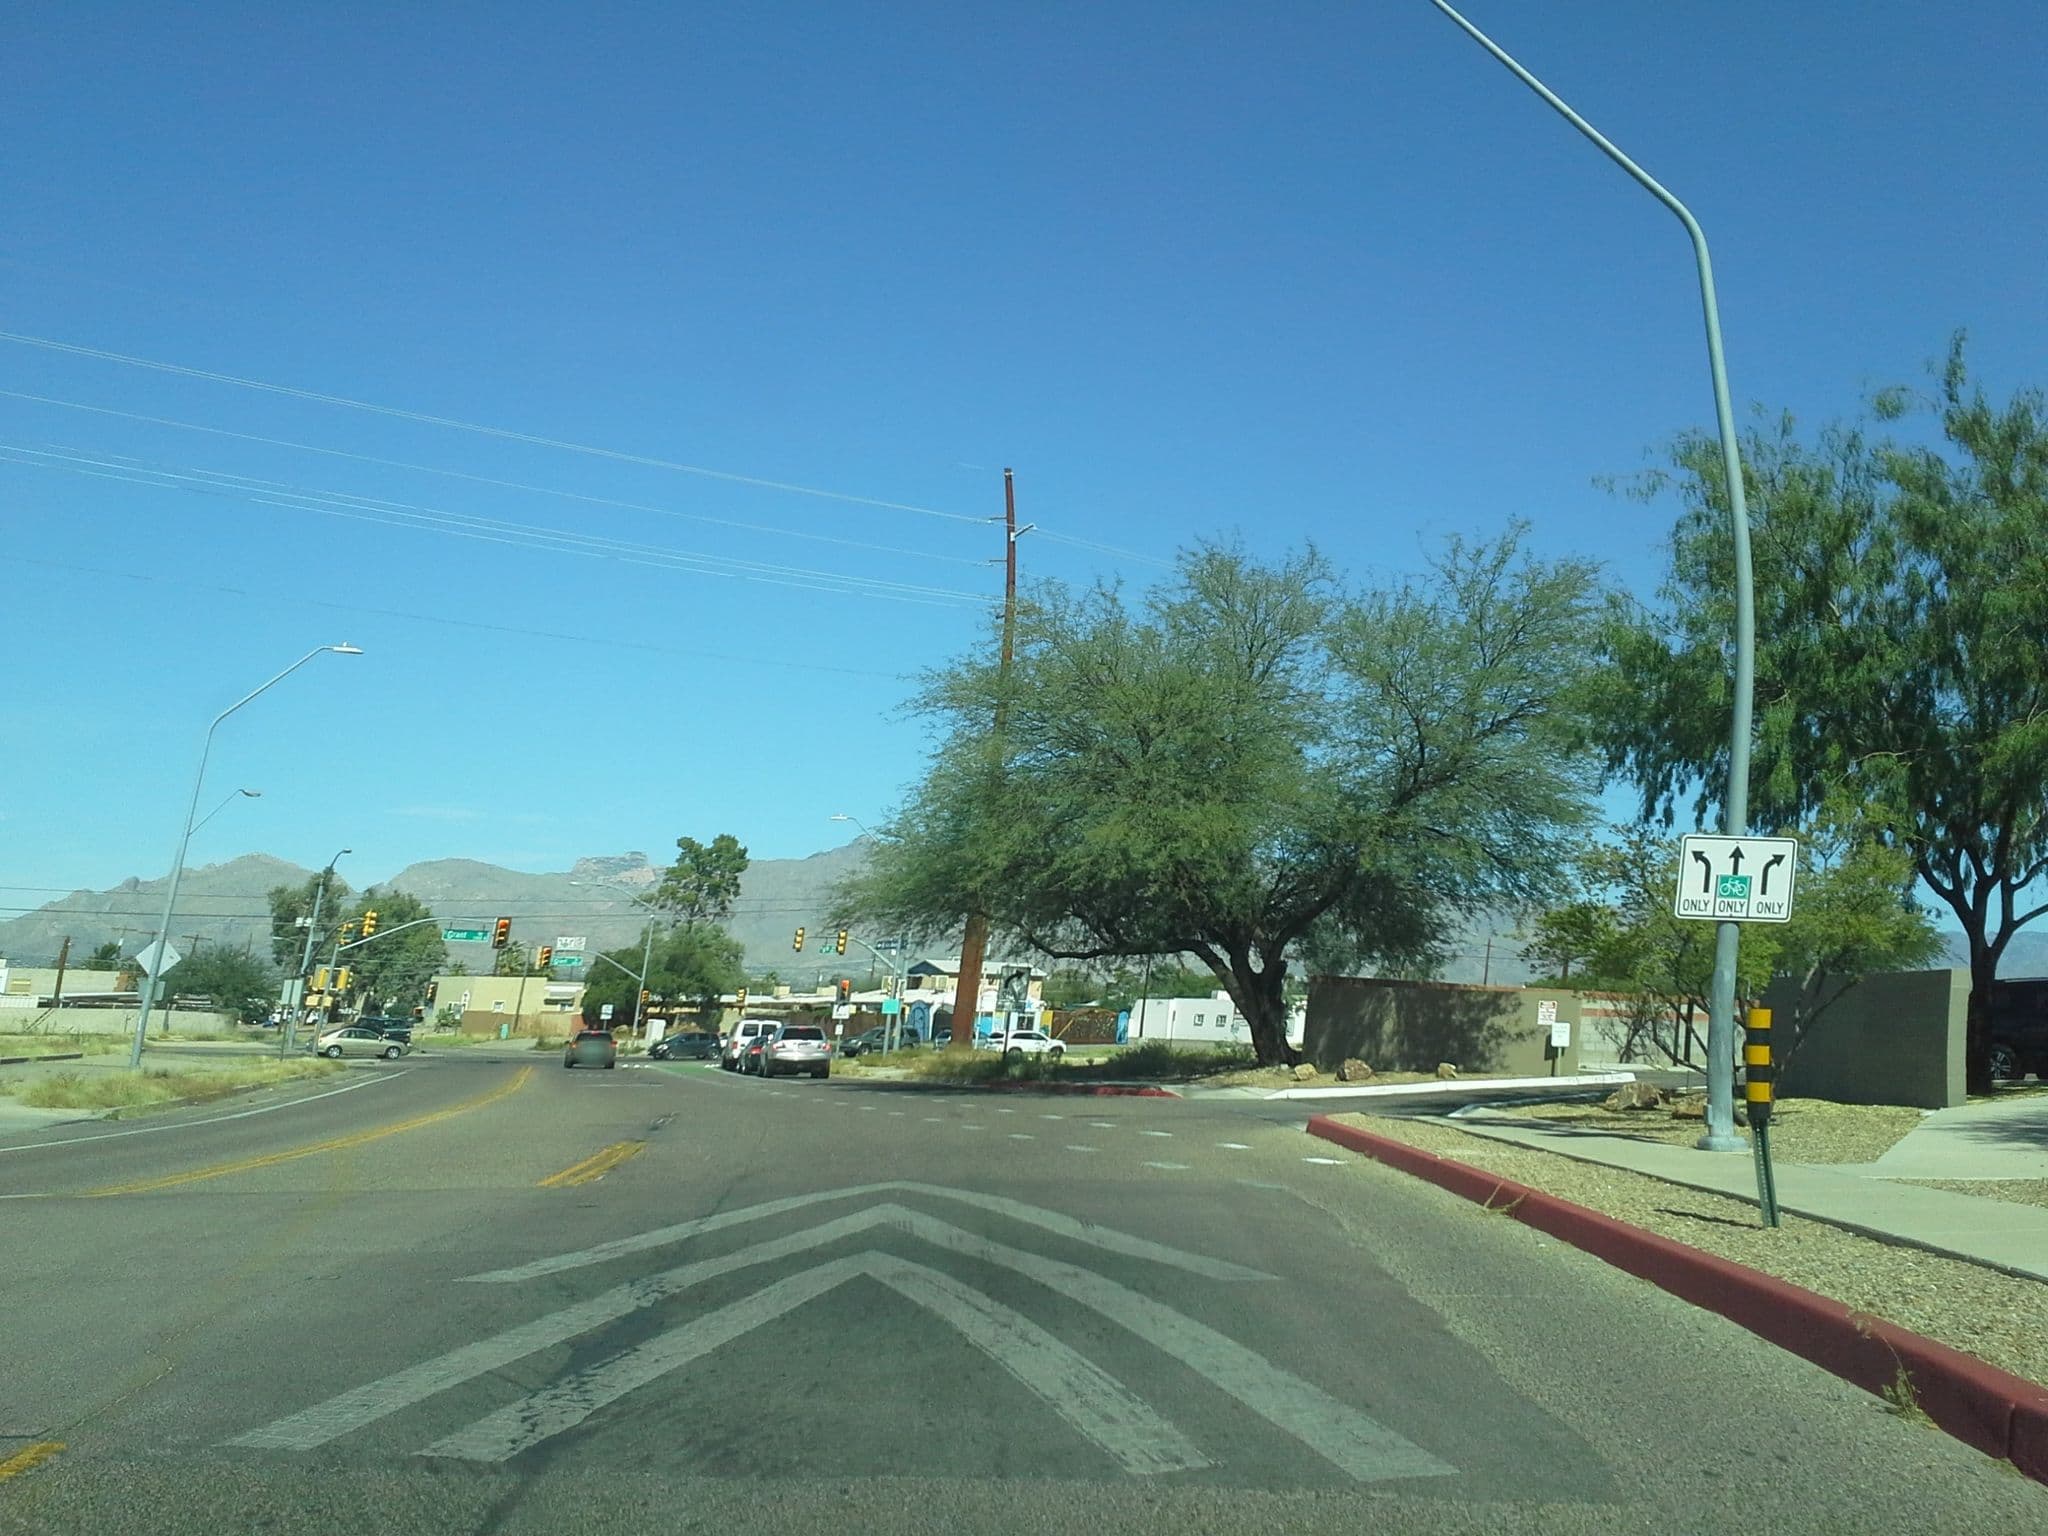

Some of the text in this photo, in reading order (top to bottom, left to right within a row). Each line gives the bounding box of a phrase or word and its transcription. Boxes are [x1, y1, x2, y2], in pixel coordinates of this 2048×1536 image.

[1682, 899, 1710, 912] ONLY
[1718, 900, 1746, 913] ONLY
[1756, 901, 1784, 915] ONLY
